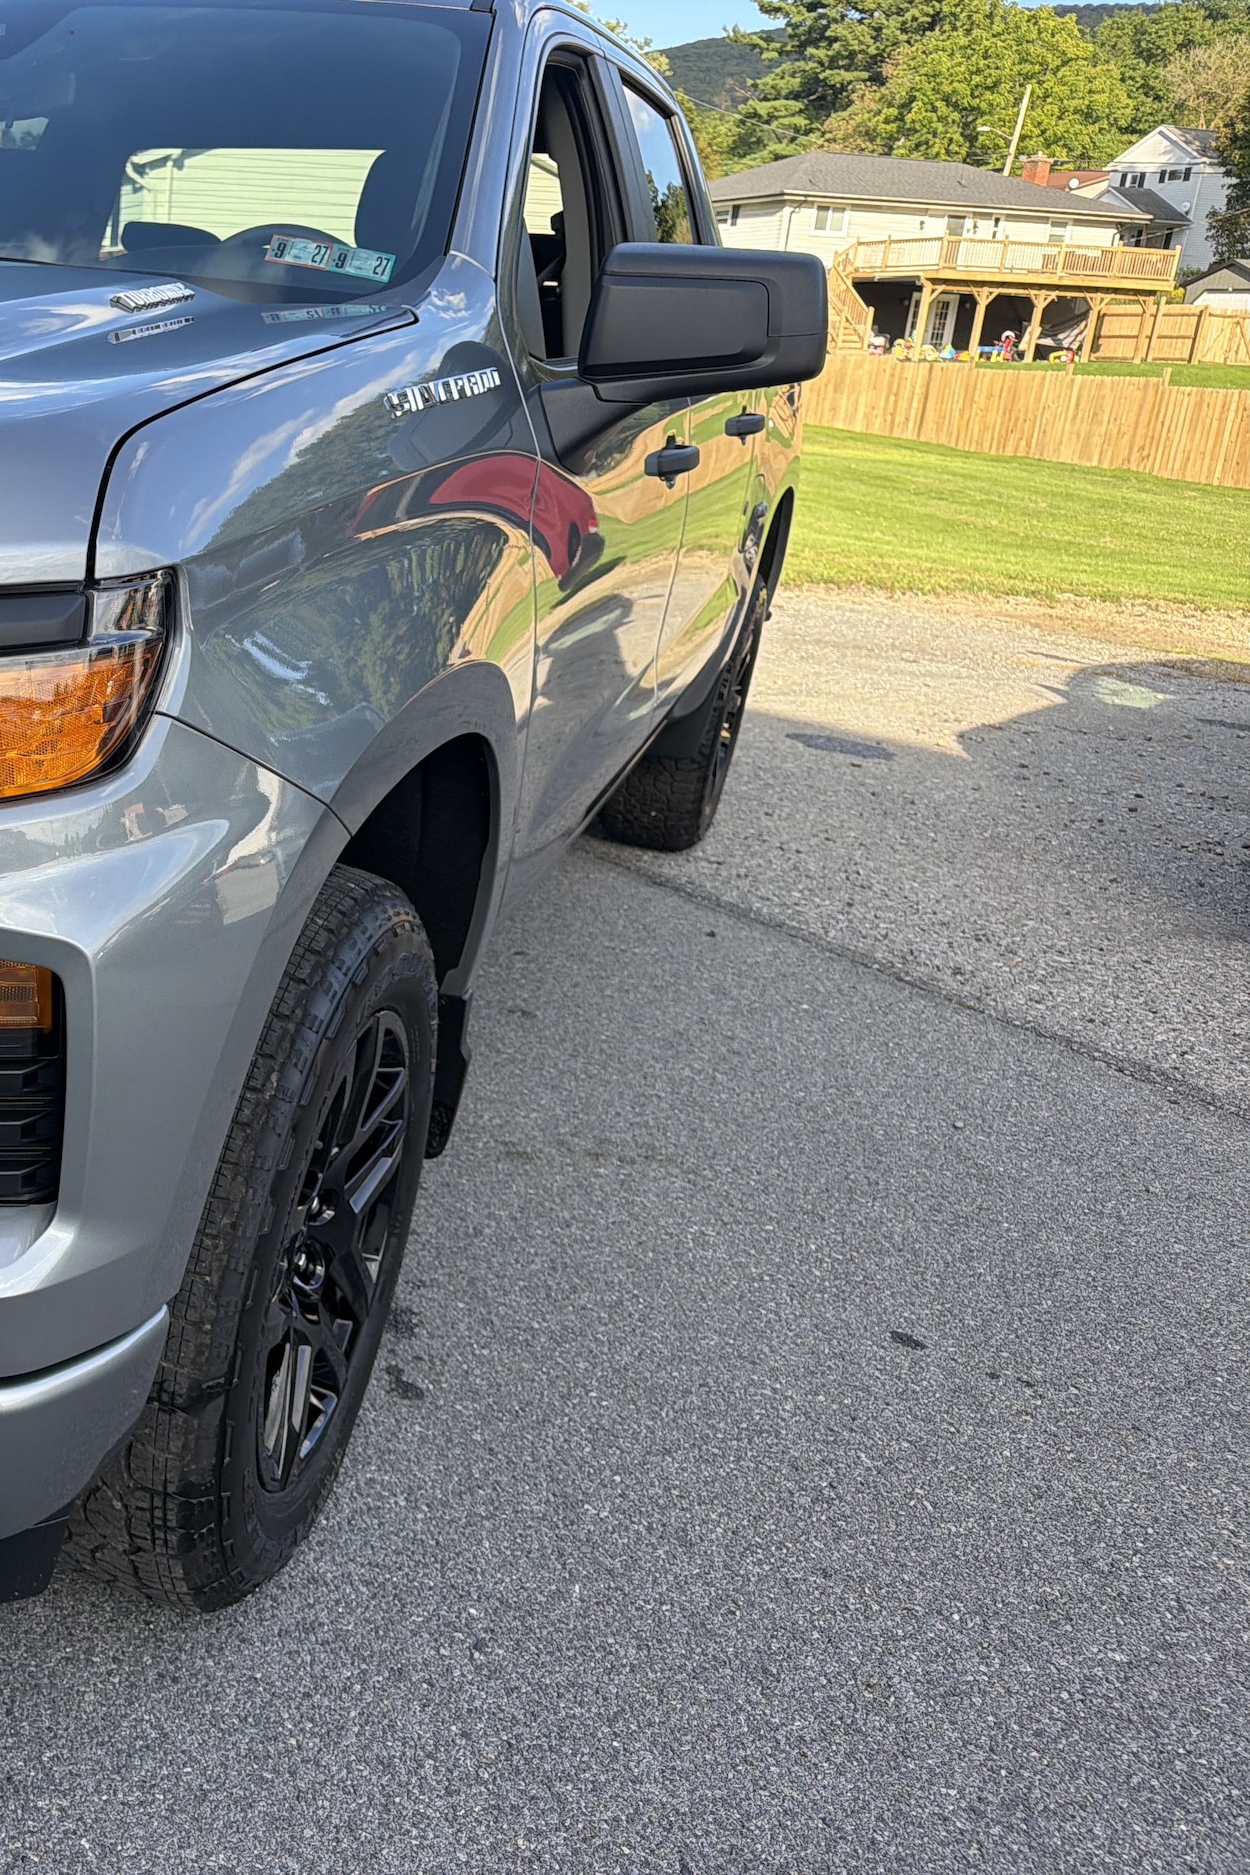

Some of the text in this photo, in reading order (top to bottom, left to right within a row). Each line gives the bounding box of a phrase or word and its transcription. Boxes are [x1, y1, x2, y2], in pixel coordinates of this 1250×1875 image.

[274, 242, 287, 259] 9
[311, 244, 329, 266] 27
[335, 252, 348, 269] 9
[372, 256, 390, 277] 27
[383, 366, 501, 419] SILVERADO
